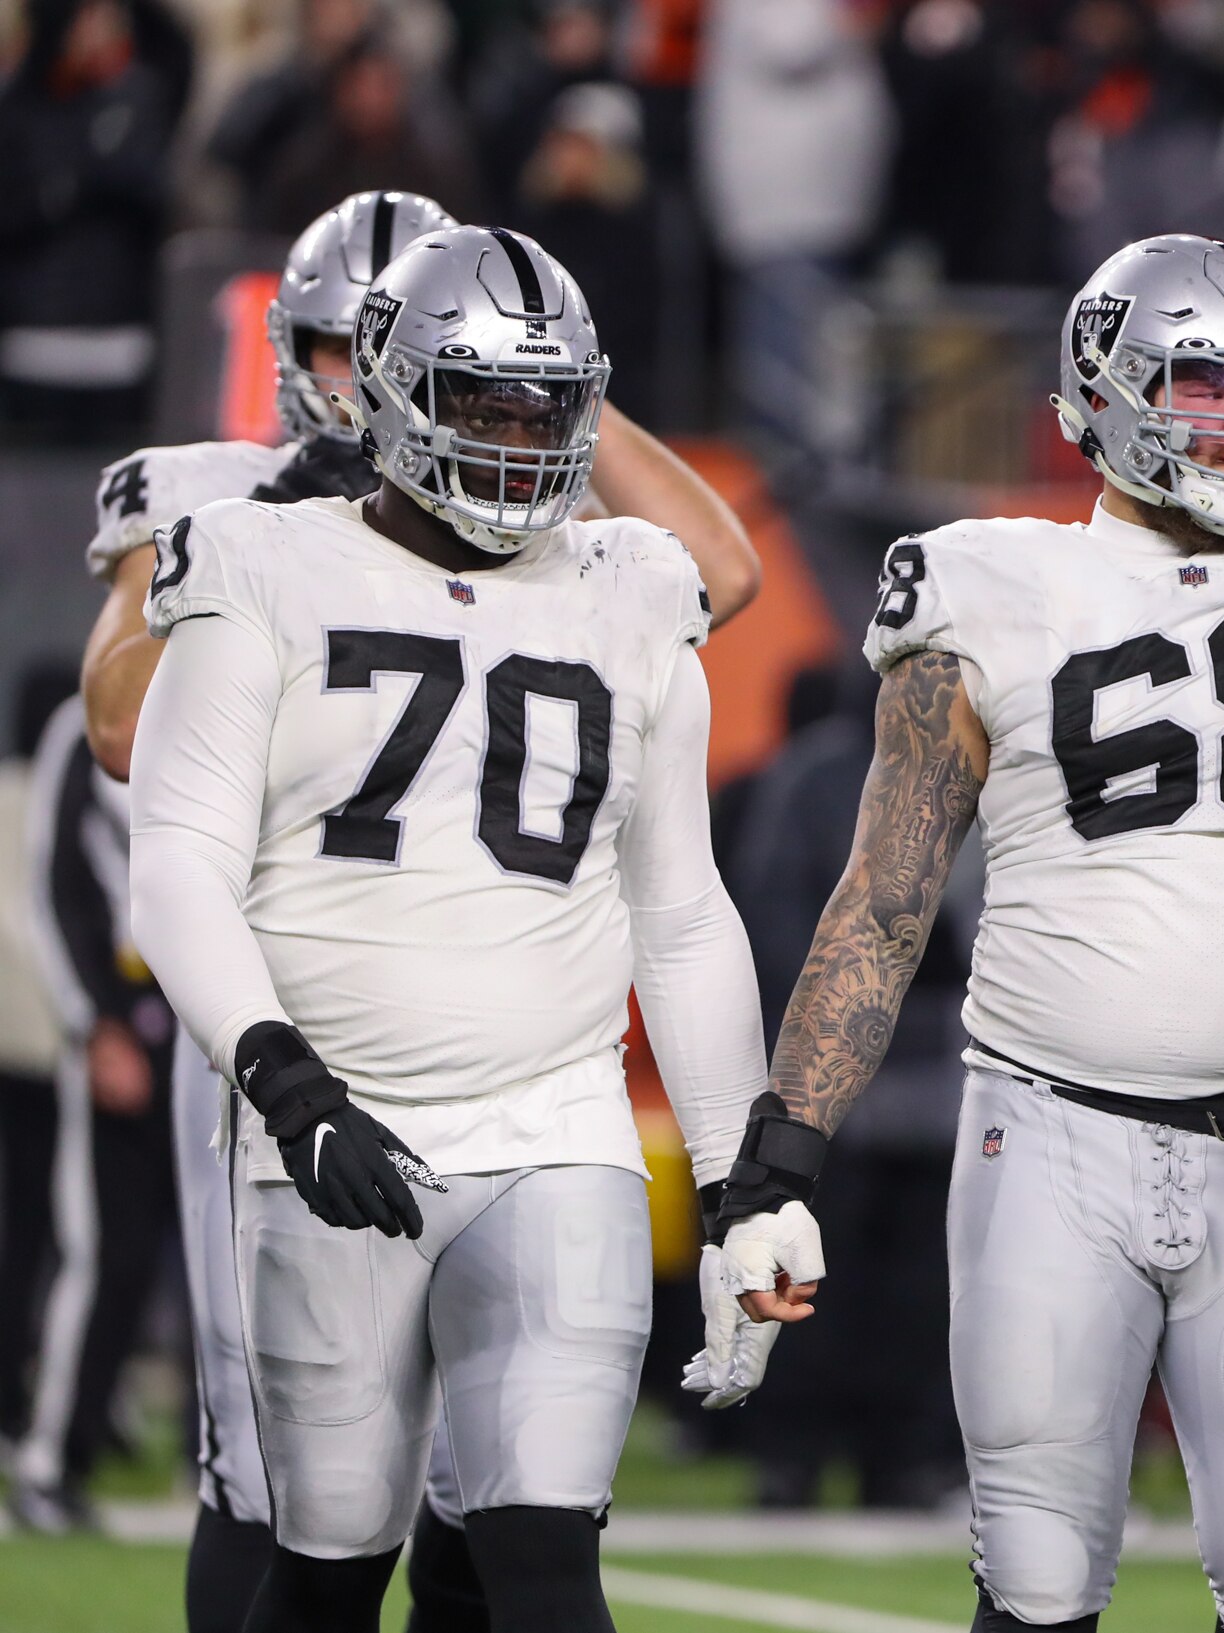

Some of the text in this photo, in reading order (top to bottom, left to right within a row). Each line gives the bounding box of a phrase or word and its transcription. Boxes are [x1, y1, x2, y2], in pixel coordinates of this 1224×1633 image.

[1080, 300, 1123, 312] RAIDERS
[515, 344, 561, 356] RAIDERS
[102, 458, 149, 518] 4
[315, 625, 615, 889] 70
